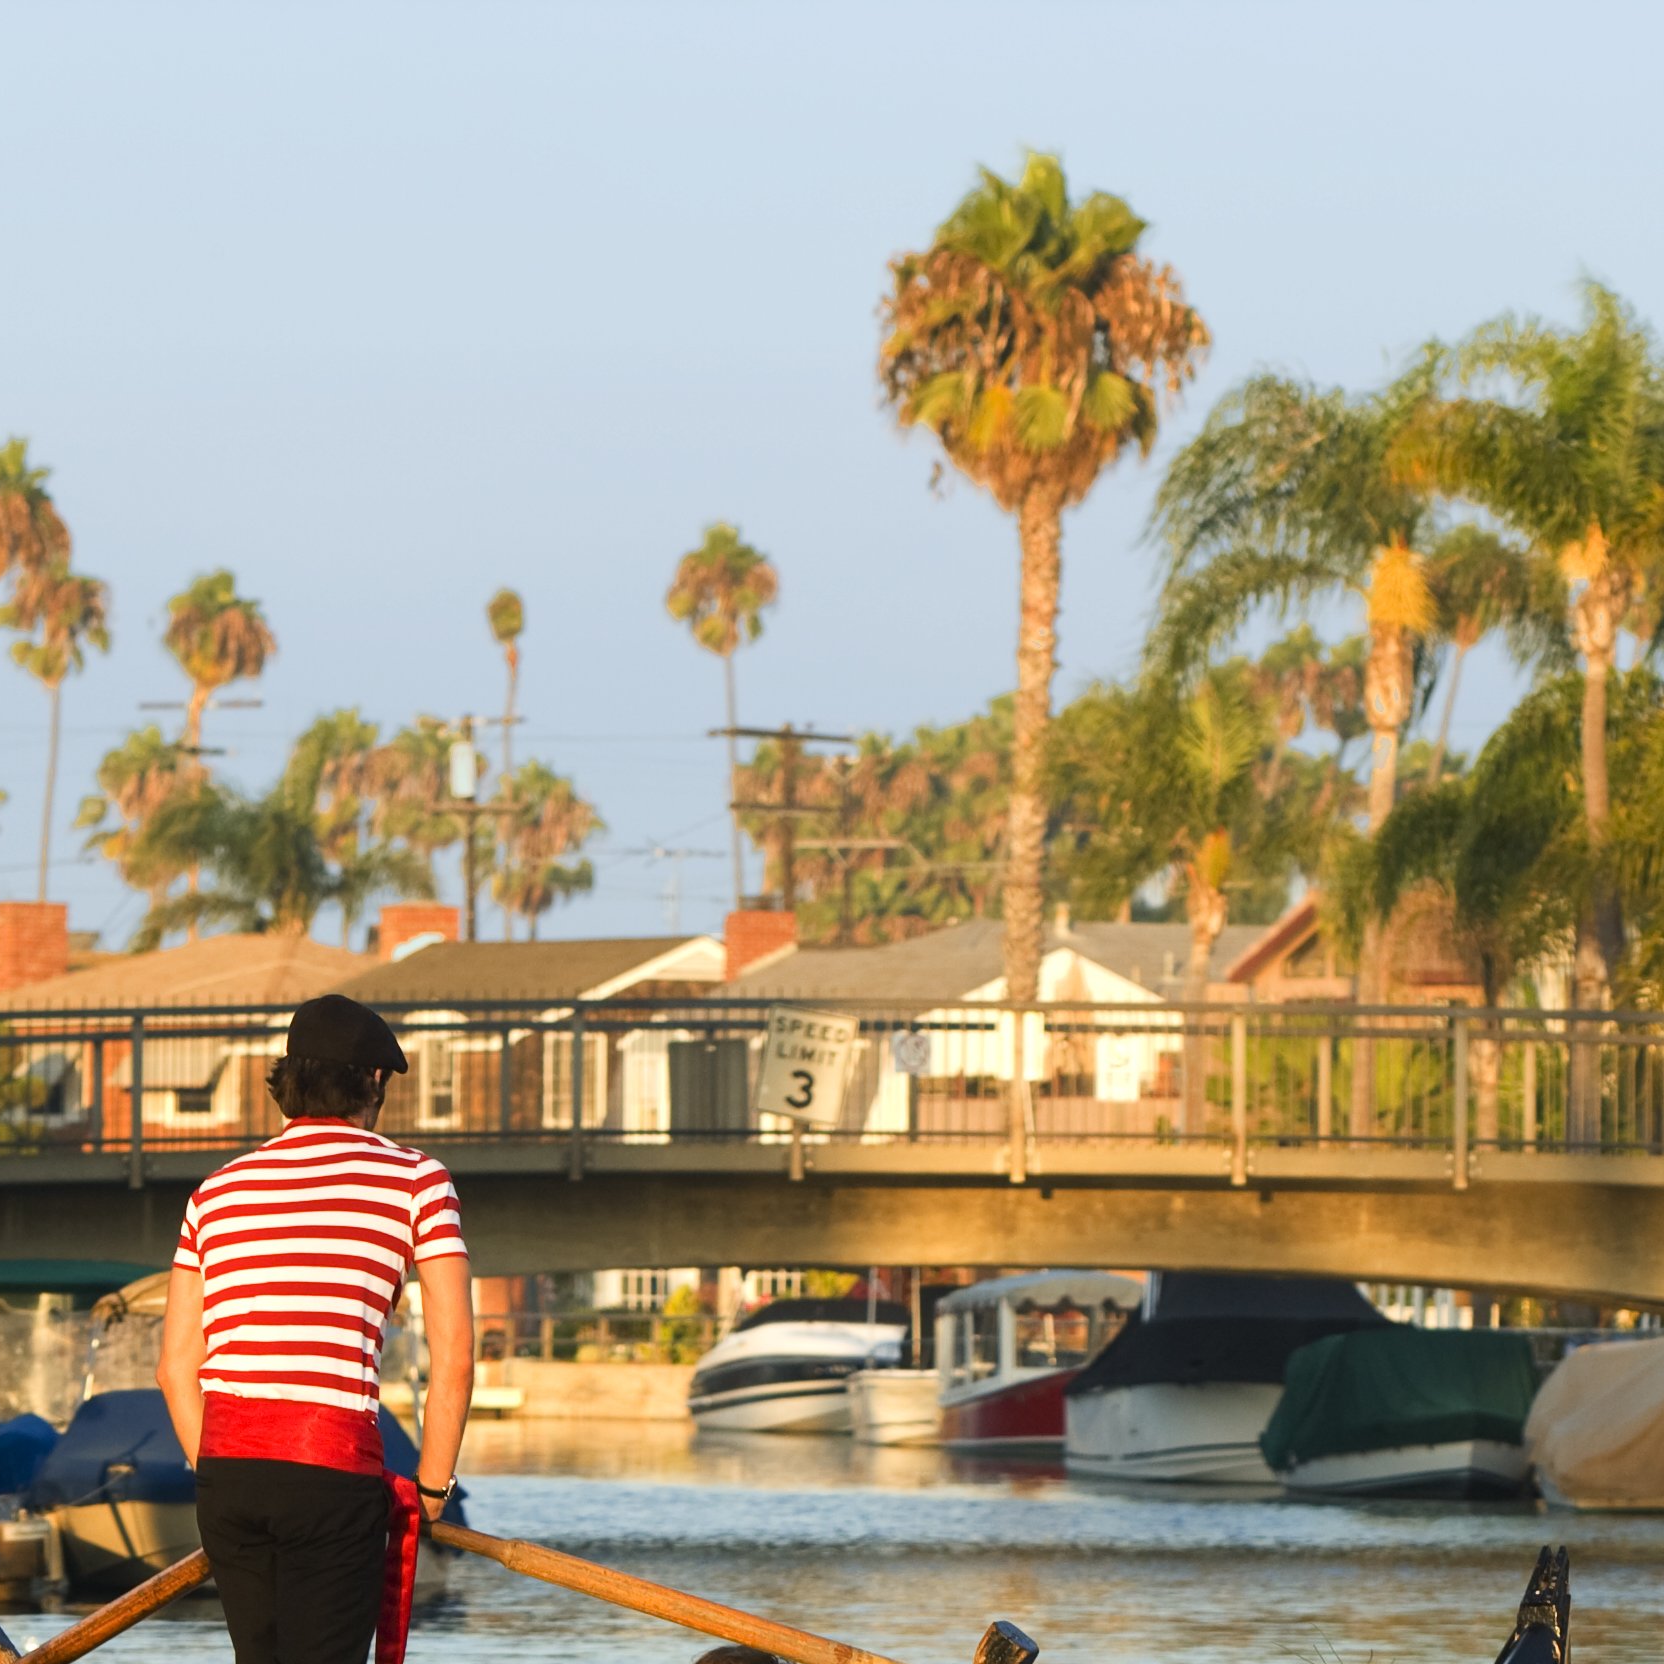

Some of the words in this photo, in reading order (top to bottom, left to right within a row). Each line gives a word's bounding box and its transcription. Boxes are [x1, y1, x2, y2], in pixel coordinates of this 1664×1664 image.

[776, 1016, 848, 1043] SPEED
[777, 1041, 838, 1066] LIMIT
[784, 1070, 814, 1109] 3
